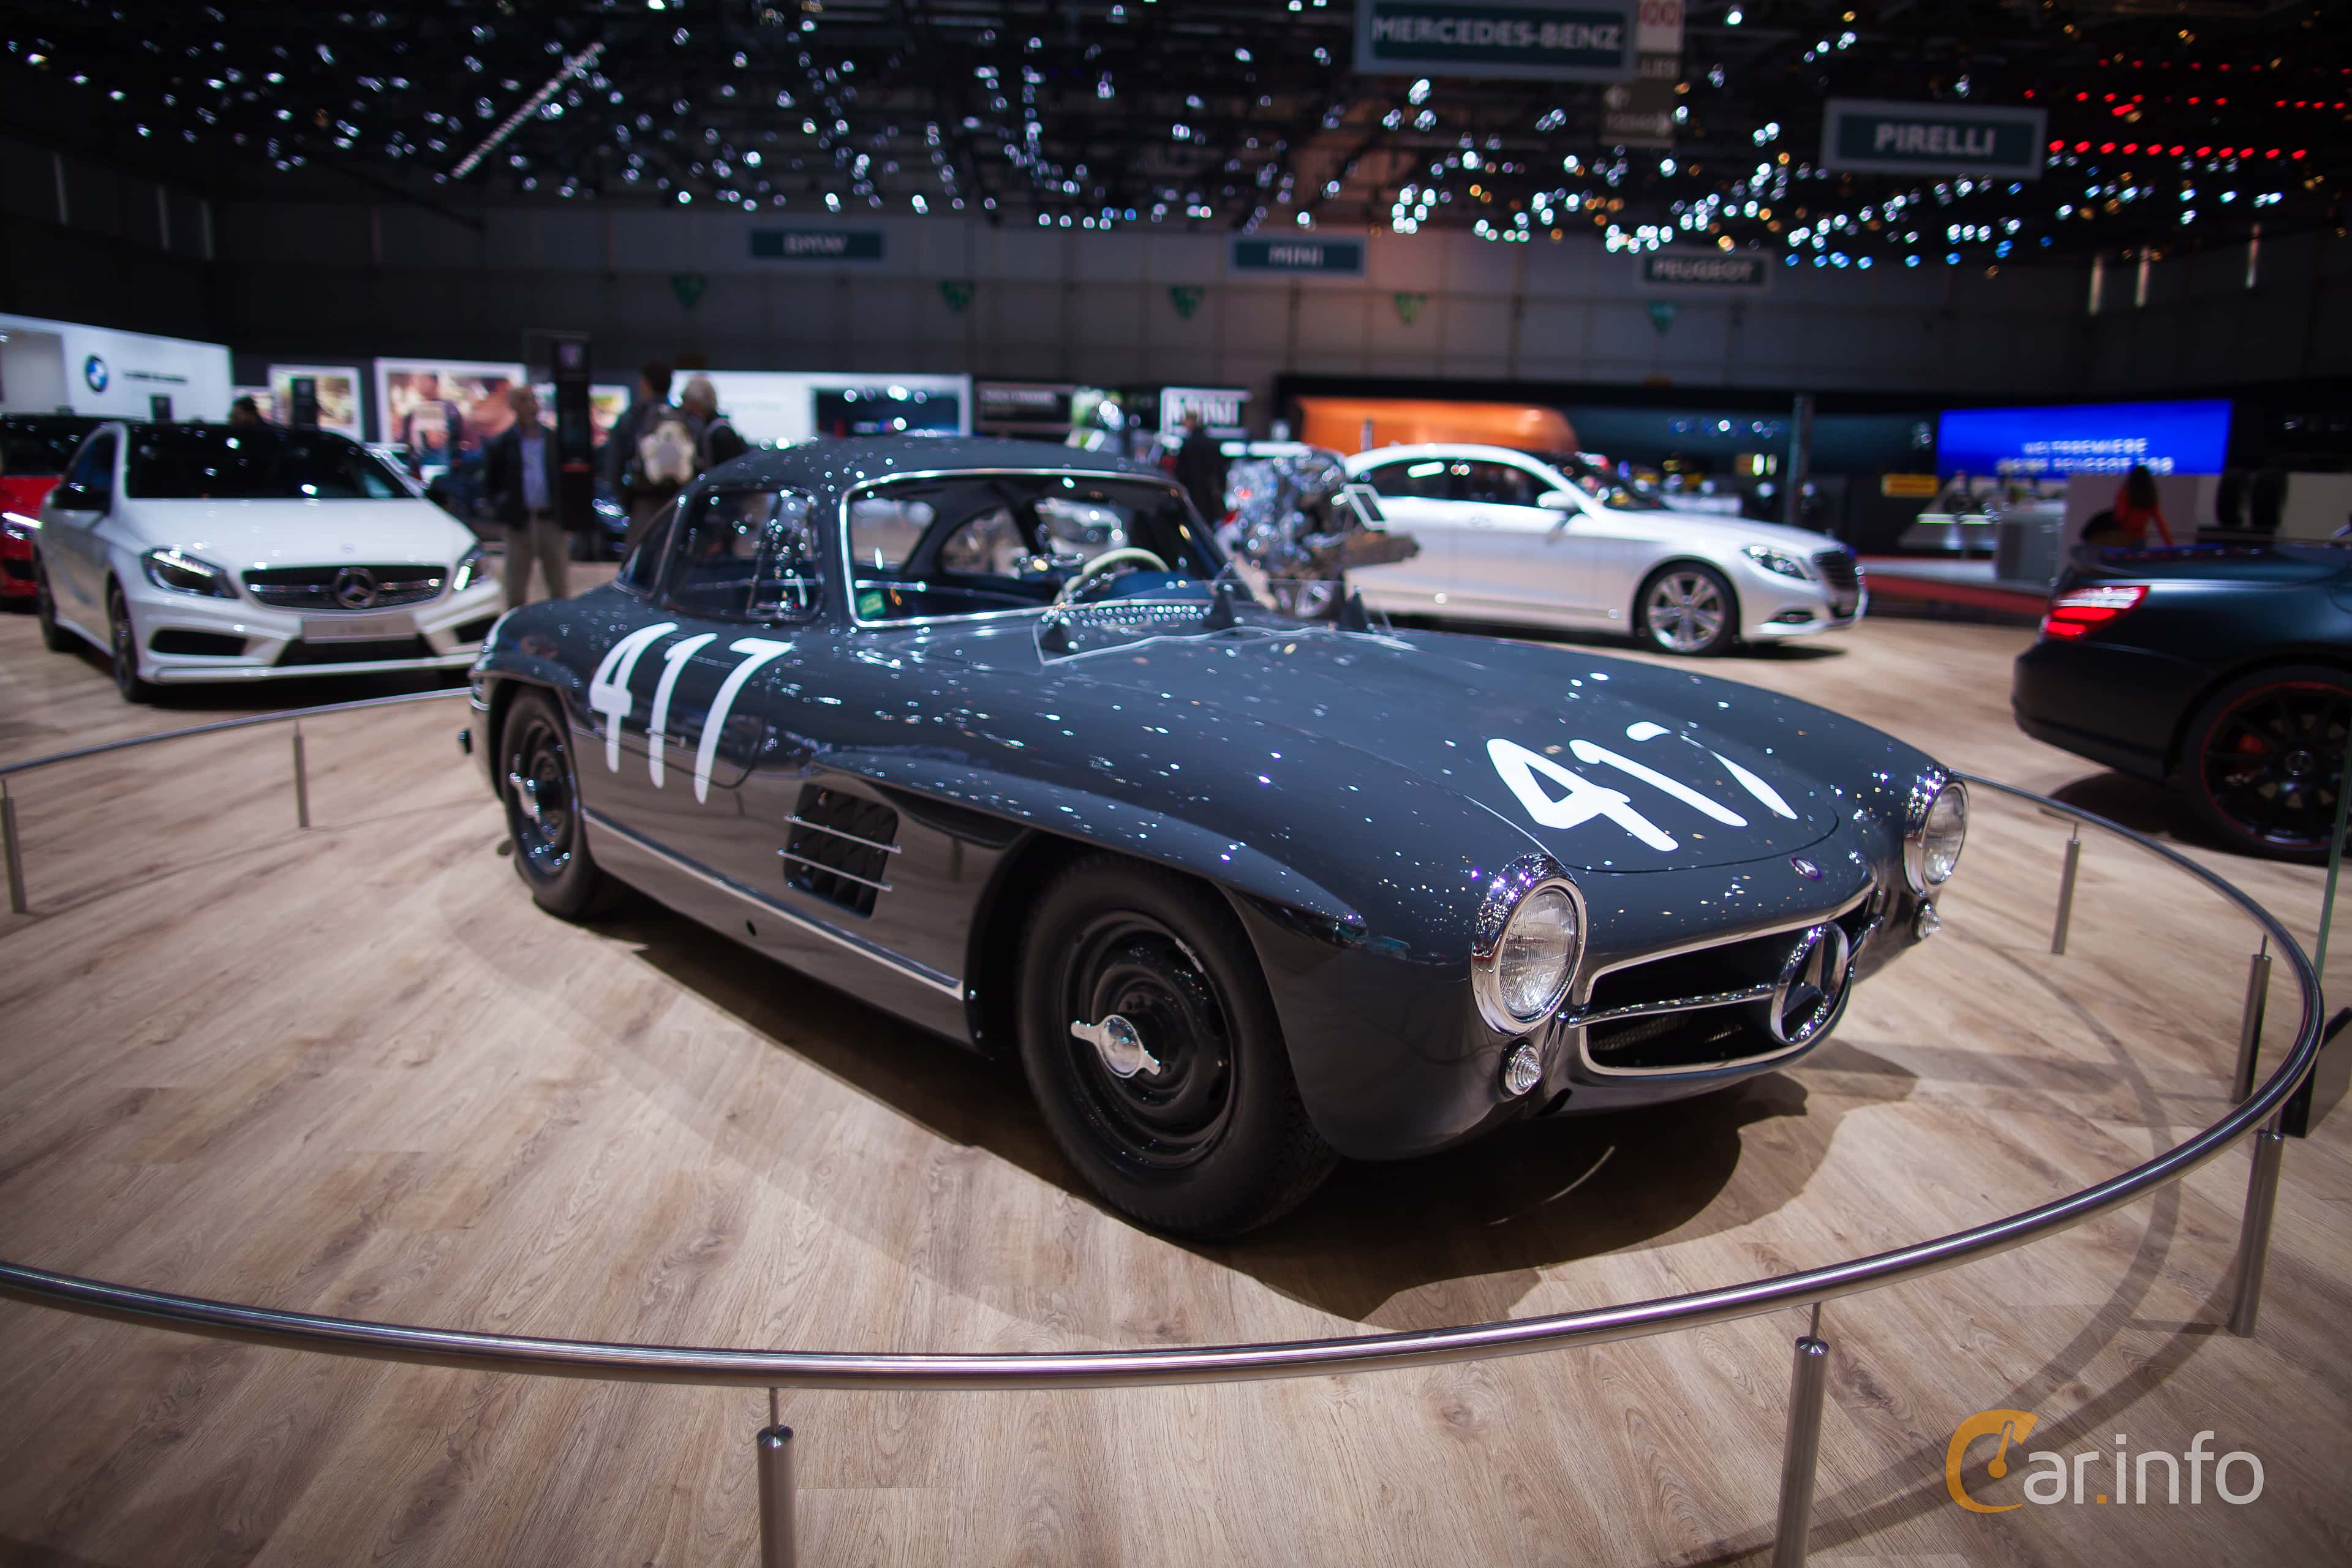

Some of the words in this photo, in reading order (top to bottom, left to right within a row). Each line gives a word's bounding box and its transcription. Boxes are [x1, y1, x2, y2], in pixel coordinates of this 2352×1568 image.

[1373, 17, 1621, 50] MERCEDES-BENZ
[1874, 123, 1996, 155] PIRELLI
[1269, 245, 1324, 266] MINI
[1653, 258, 1754, 283] PEUGEOT
[589, 621, 793, 805] 417
[1486, 721, 1799, 851] 417
